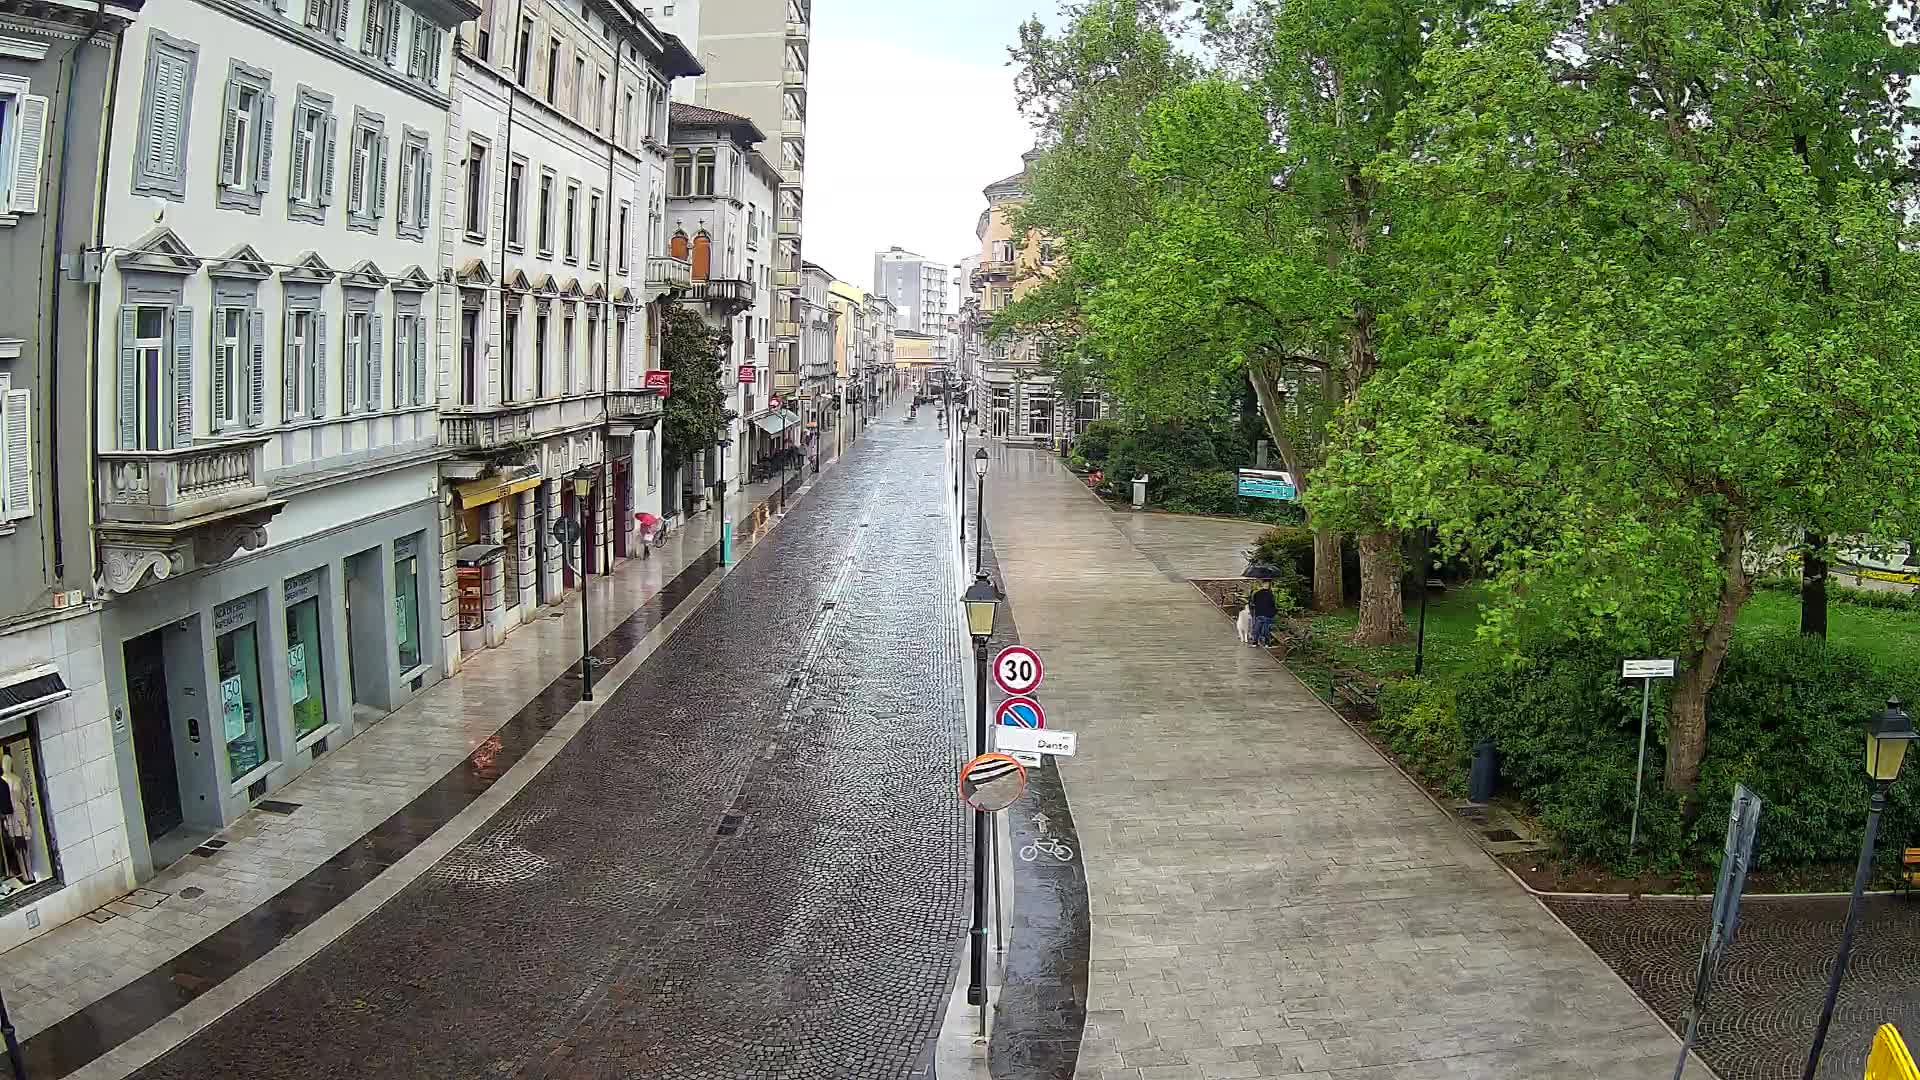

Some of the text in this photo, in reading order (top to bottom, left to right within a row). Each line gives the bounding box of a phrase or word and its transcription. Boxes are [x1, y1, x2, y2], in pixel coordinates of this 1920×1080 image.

[1004, 659, 1032, 681] 30
[223, 679, 240, 701] 130
[1037, 740, 1069, 751] Dante
